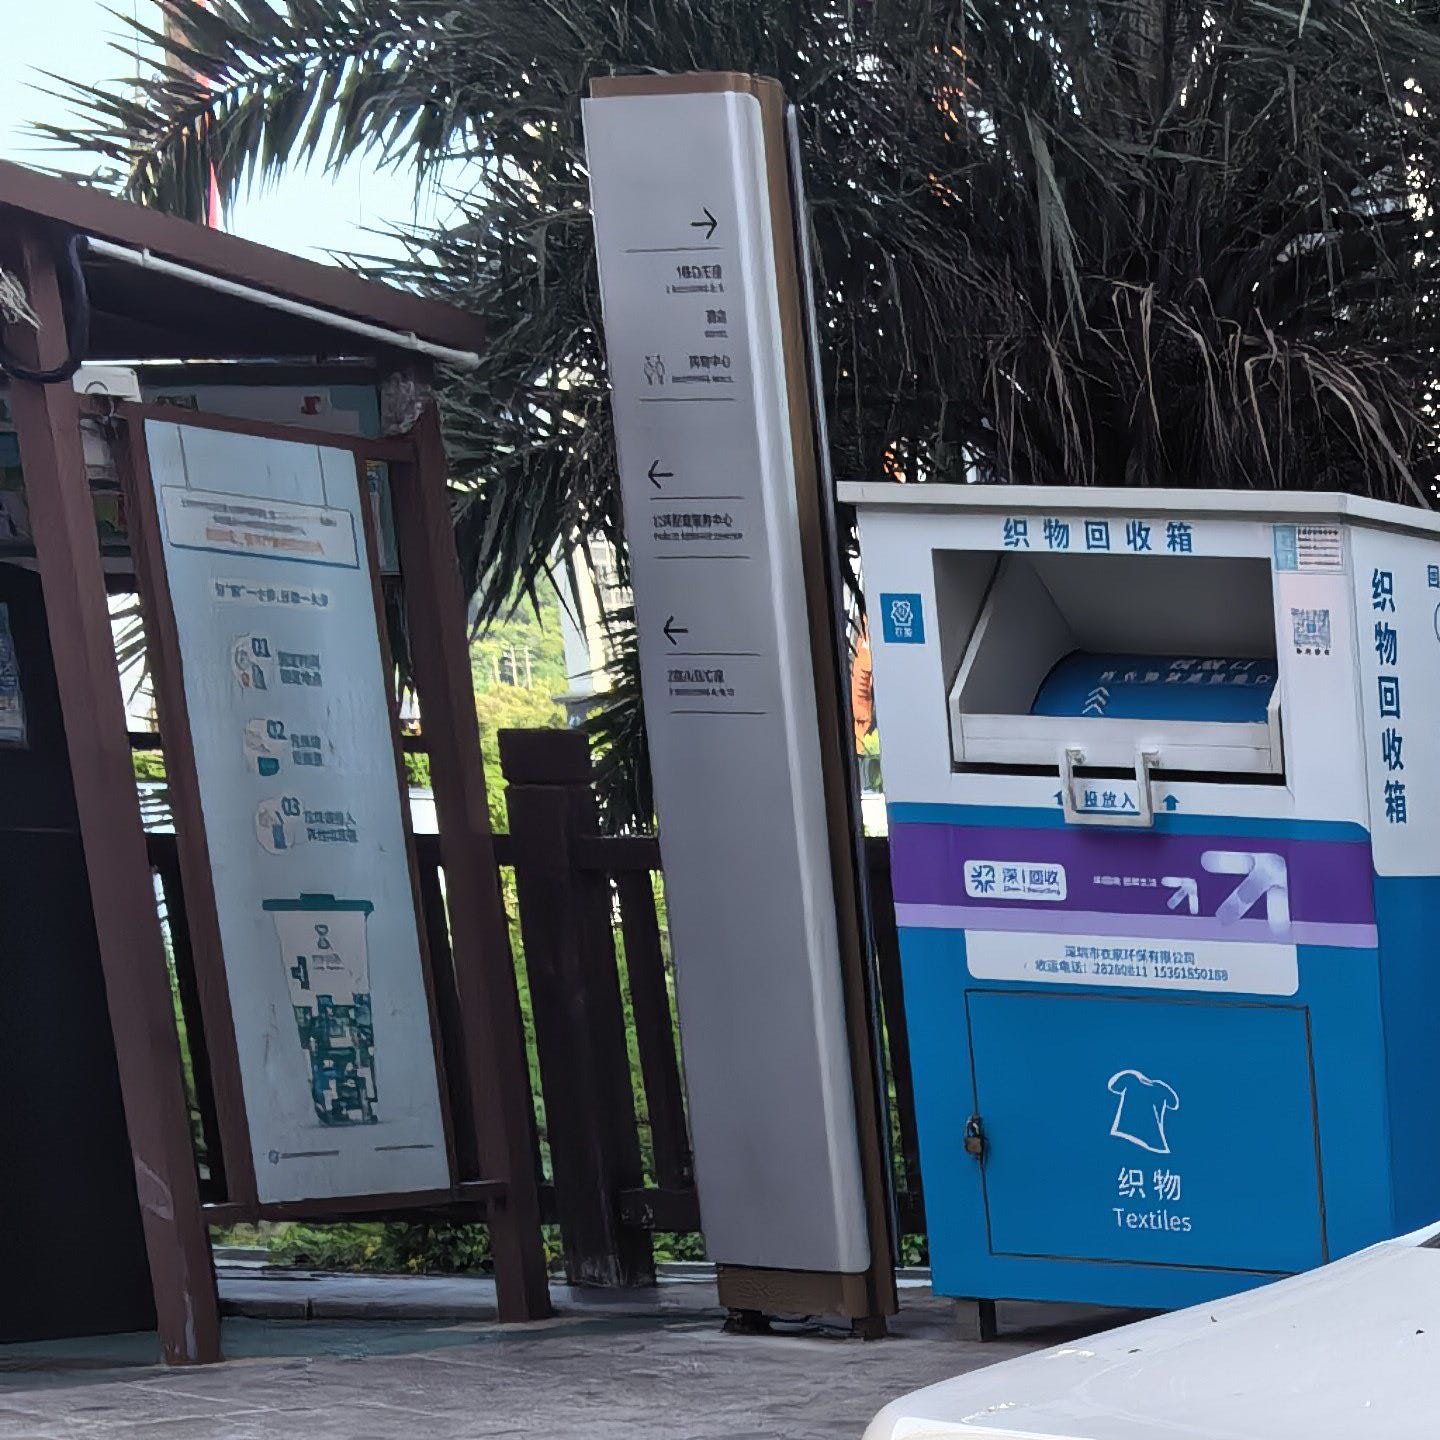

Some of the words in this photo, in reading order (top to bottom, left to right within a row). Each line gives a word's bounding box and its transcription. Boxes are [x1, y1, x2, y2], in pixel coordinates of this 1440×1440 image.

[1003, 517, 1194, 553] 织物回收箱
[1371, 567, 1407, 825] 织物回收箱
[1117, 1166, 1181, 1201] 织物
[1112, 1206, 1193, 1232] Textiles
